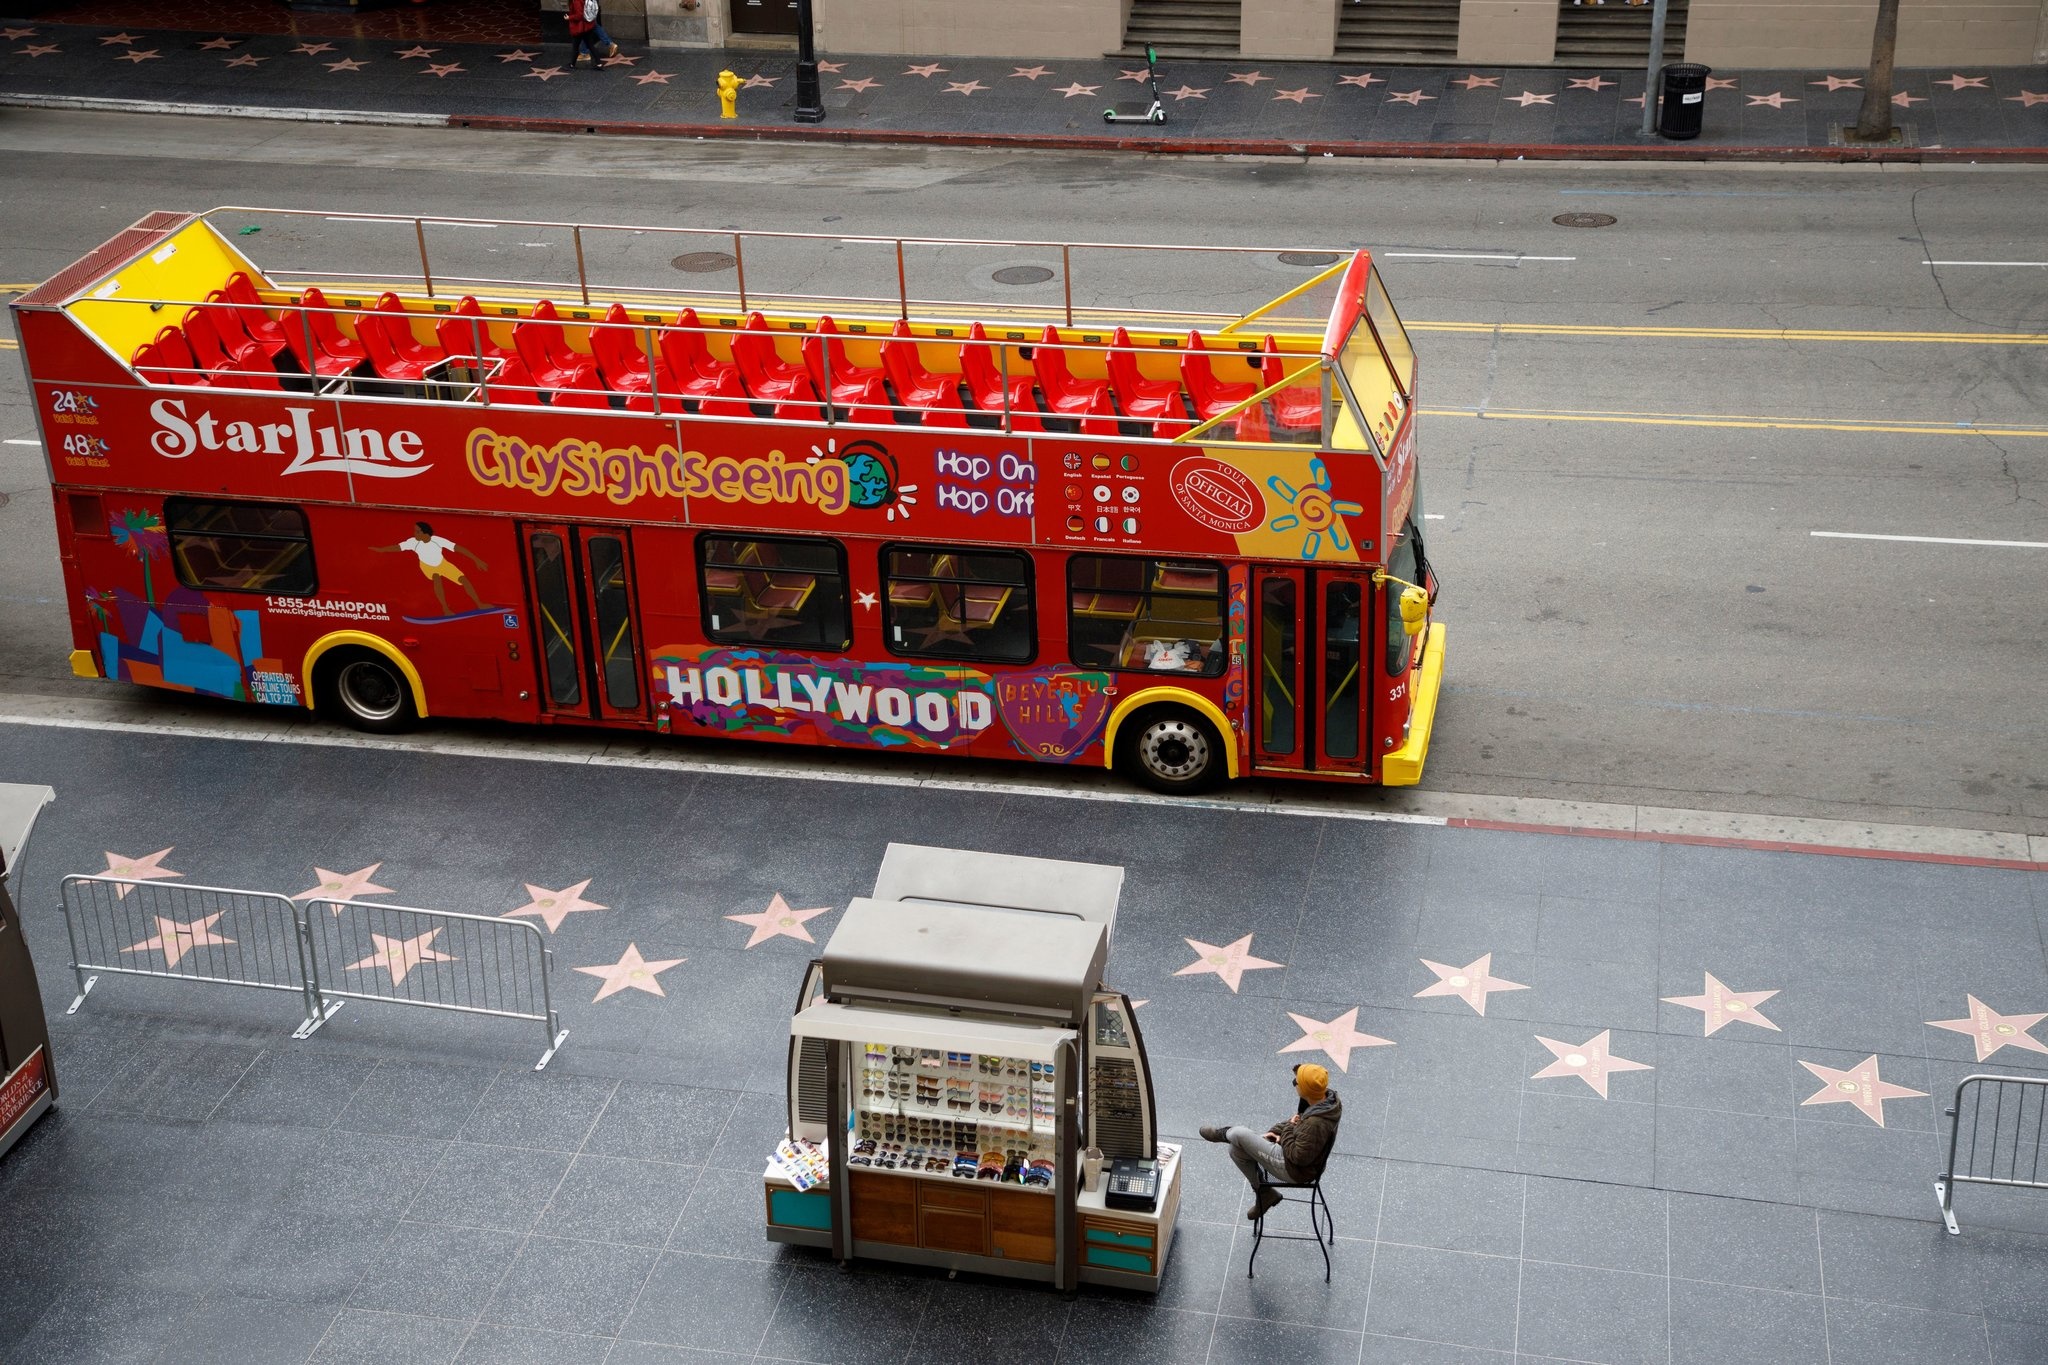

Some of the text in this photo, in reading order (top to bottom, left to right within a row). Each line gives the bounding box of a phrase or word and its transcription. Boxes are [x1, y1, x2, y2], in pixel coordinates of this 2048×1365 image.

[51, 390, 77, 412] 24
[64, 434, 90, 455] 48
[150, 398, 434, 478] StarLine
[466, 427, 850, 515] CitySightseeing
[936, 450, 1035, 482] Hop On
[1217, 463, 1246, 486] TOUR
[937, 485, 1034, 516] Hop Off
[1189, 475, 1247, 515] OFFICIAL
[1175, 483, 1251, 530] OF SANTA MONICA
[265, 596, 387, 614] 1-855-4LAHOPON
[268, 607, 390, 621] www.CitySightseeingLA.com
[1232, 656, 1241, 664] 45
[251, 681, 301, 694] STARLINE TOURS
[252, 671, 285, 682] OPERATED
[256, 692, 293, 704] CAL TCP 227
[667, 666, 993, 732] HOLLYWOOD
[1006, 680, 1099, 702] BEVERLY
[1390, 681, 1405, 701] 331
[1020, 703, 1083, 723] HILLS
